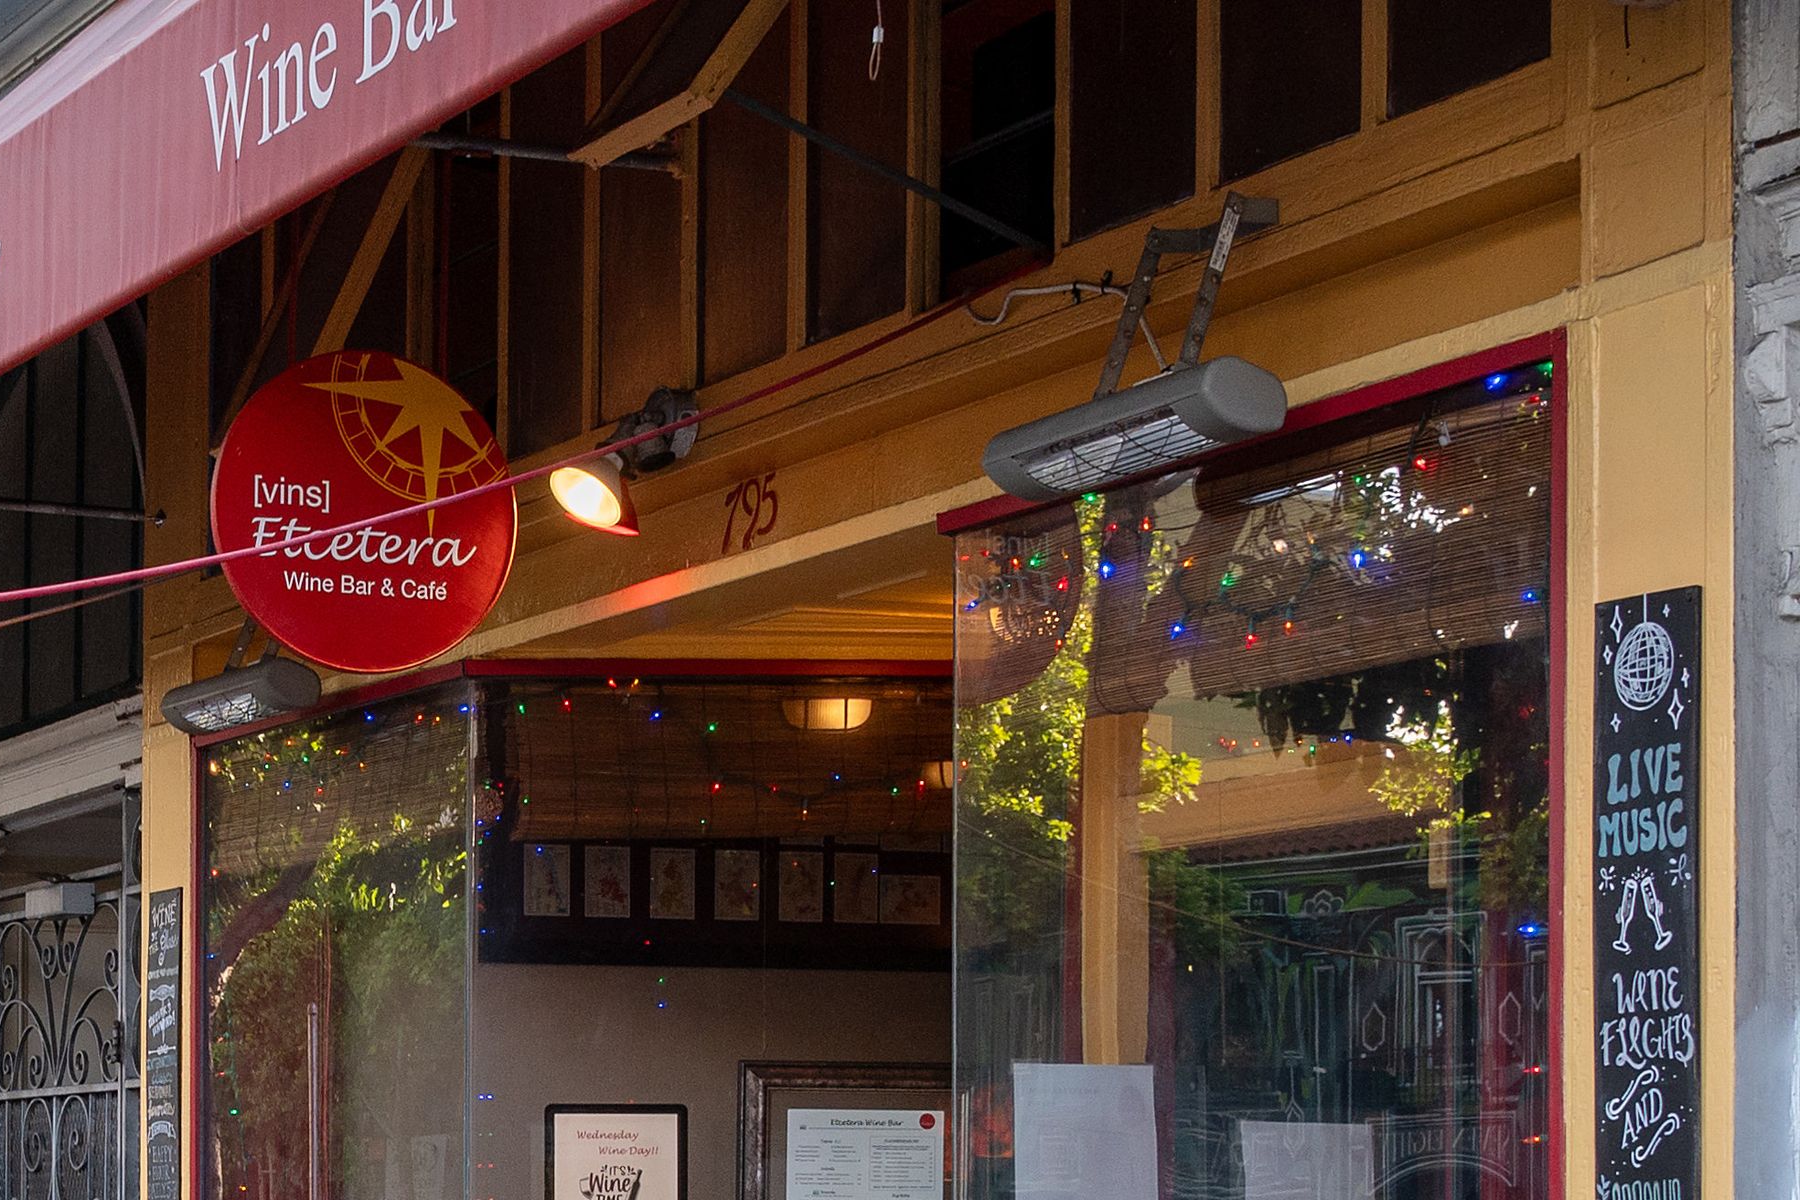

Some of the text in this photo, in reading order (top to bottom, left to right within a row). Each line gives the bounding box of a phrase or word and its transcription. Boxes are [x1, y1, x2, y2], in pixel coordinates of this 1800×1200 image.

[201, 22, 338, 173] Wine
[254, 474, 330, 513] [vins]
[721, 470, 778, 555] 795
[252, 516, 477, 567] Etcetera
[283, 570, 447, 601] Wine Bar & Café
[1607, 742, 1684, 805] LIVE
[1598, 797, 1688, 857] MUSIC
[577, 1130, 639, 1141] Wednesday
[1621, 1087, 1663, 1149] AND
[599, 1147, 628, 1155] Wine
[589, 1173, 631, 1193] Wine
